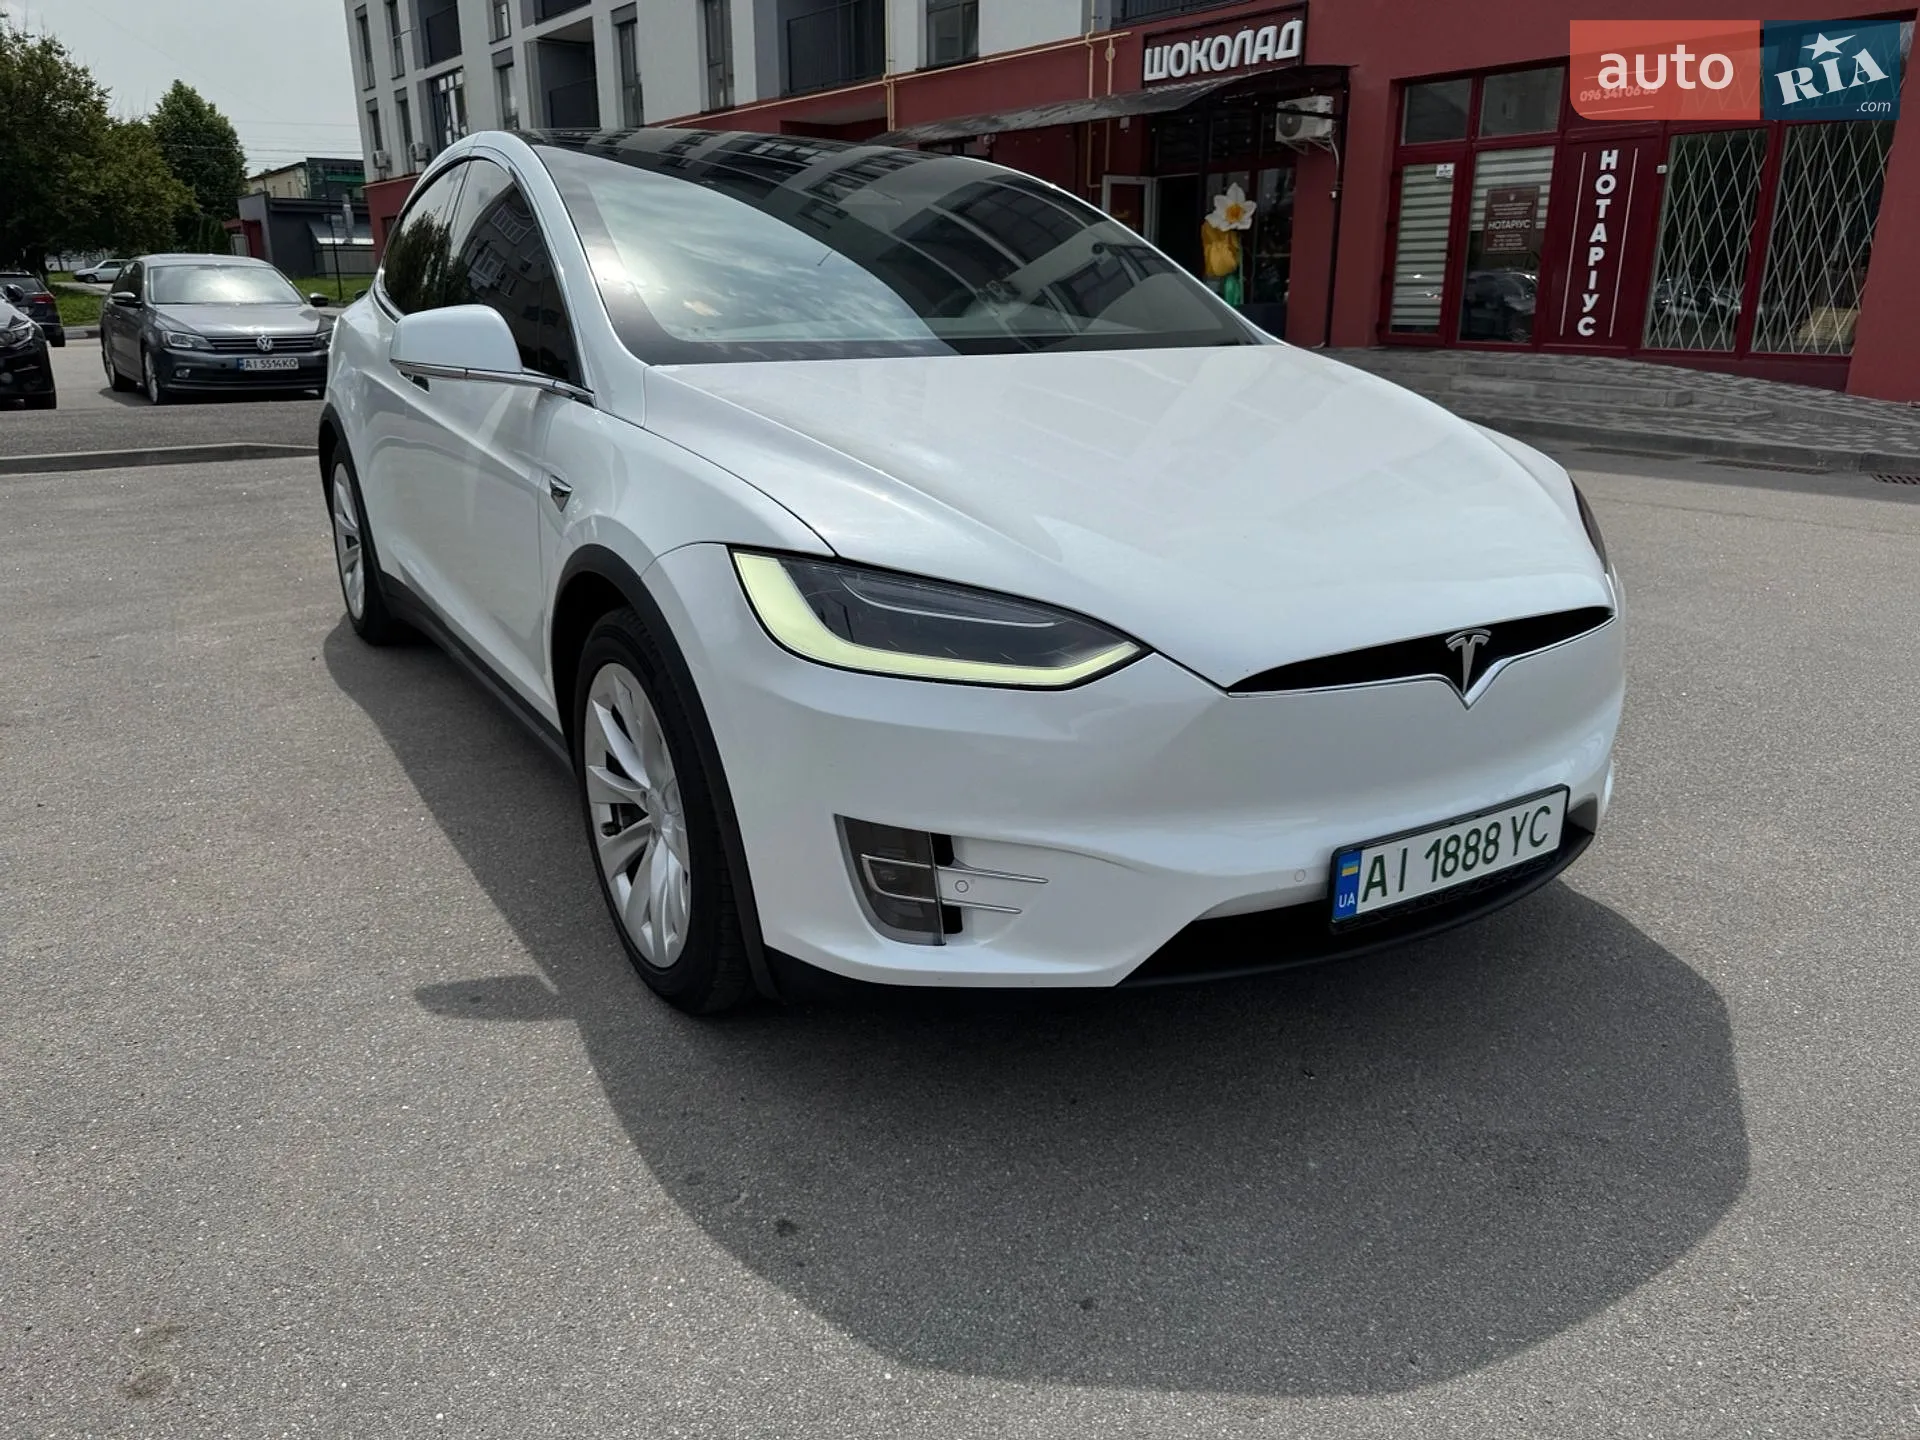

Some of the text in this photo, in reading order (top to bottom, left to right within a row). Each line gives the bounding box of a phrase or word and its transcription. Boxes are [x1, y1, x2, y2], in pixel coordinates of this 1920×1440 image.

[1144, 20, 1303, 81] ШОКОЛАД
[1577, 149, 1619, 336] НОТАРІУС
[1361, 847, 1408, 903] AI
[1424, 821, 1502, 883] 1888
[1511, 805, 1552, 857] YC
[1338, 892, 1356, 908] UA
